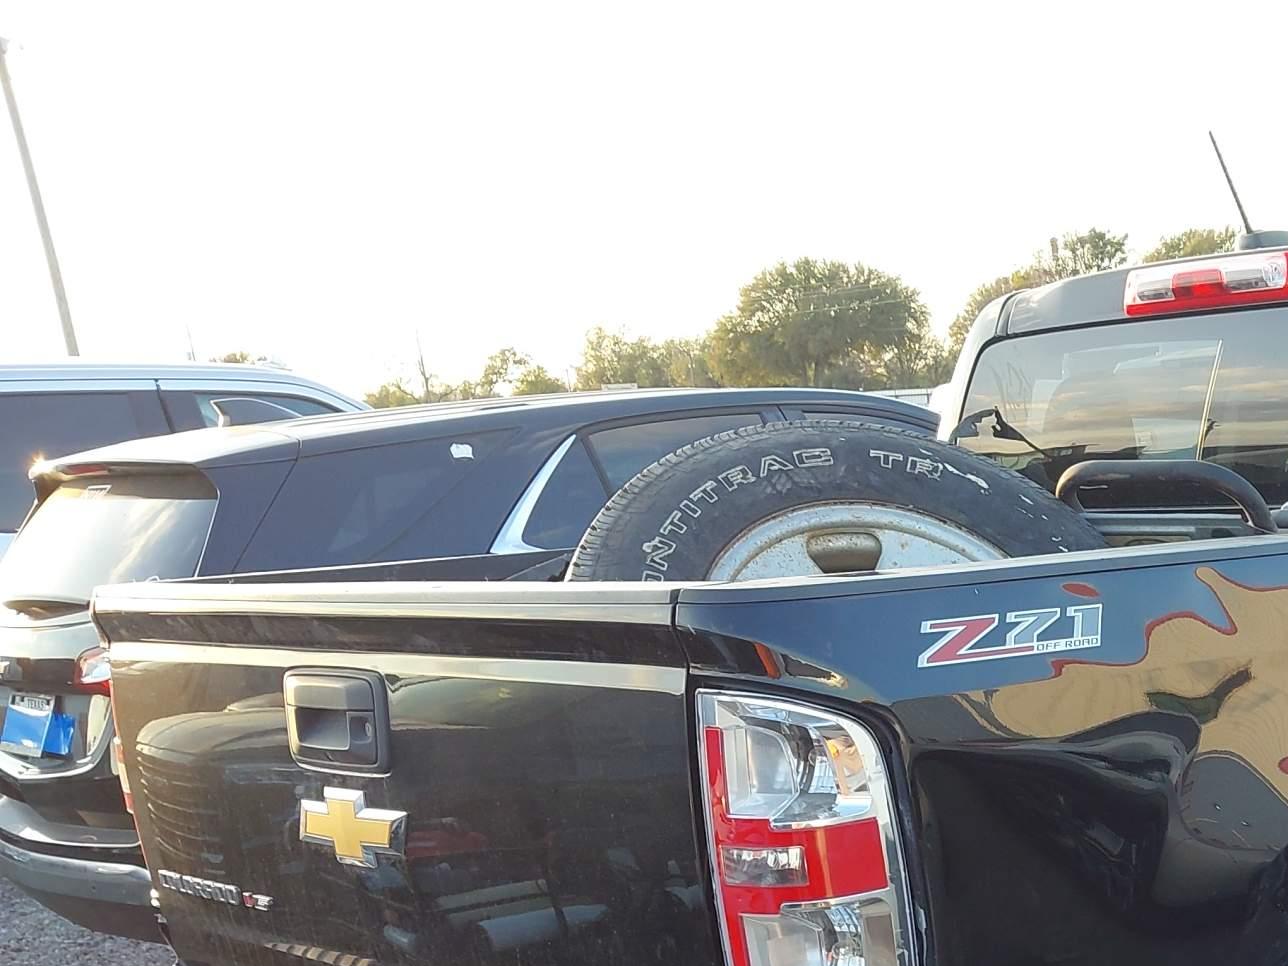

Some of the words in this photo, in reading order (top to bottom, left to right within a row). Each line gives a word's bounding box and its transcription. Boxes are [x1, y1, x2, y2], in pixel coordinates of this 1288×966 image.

[917, 603, 1103, 668] Z71
[1036, 641, 1061, 652] OFF
[1065, 637, 1099, 649] ROAD
